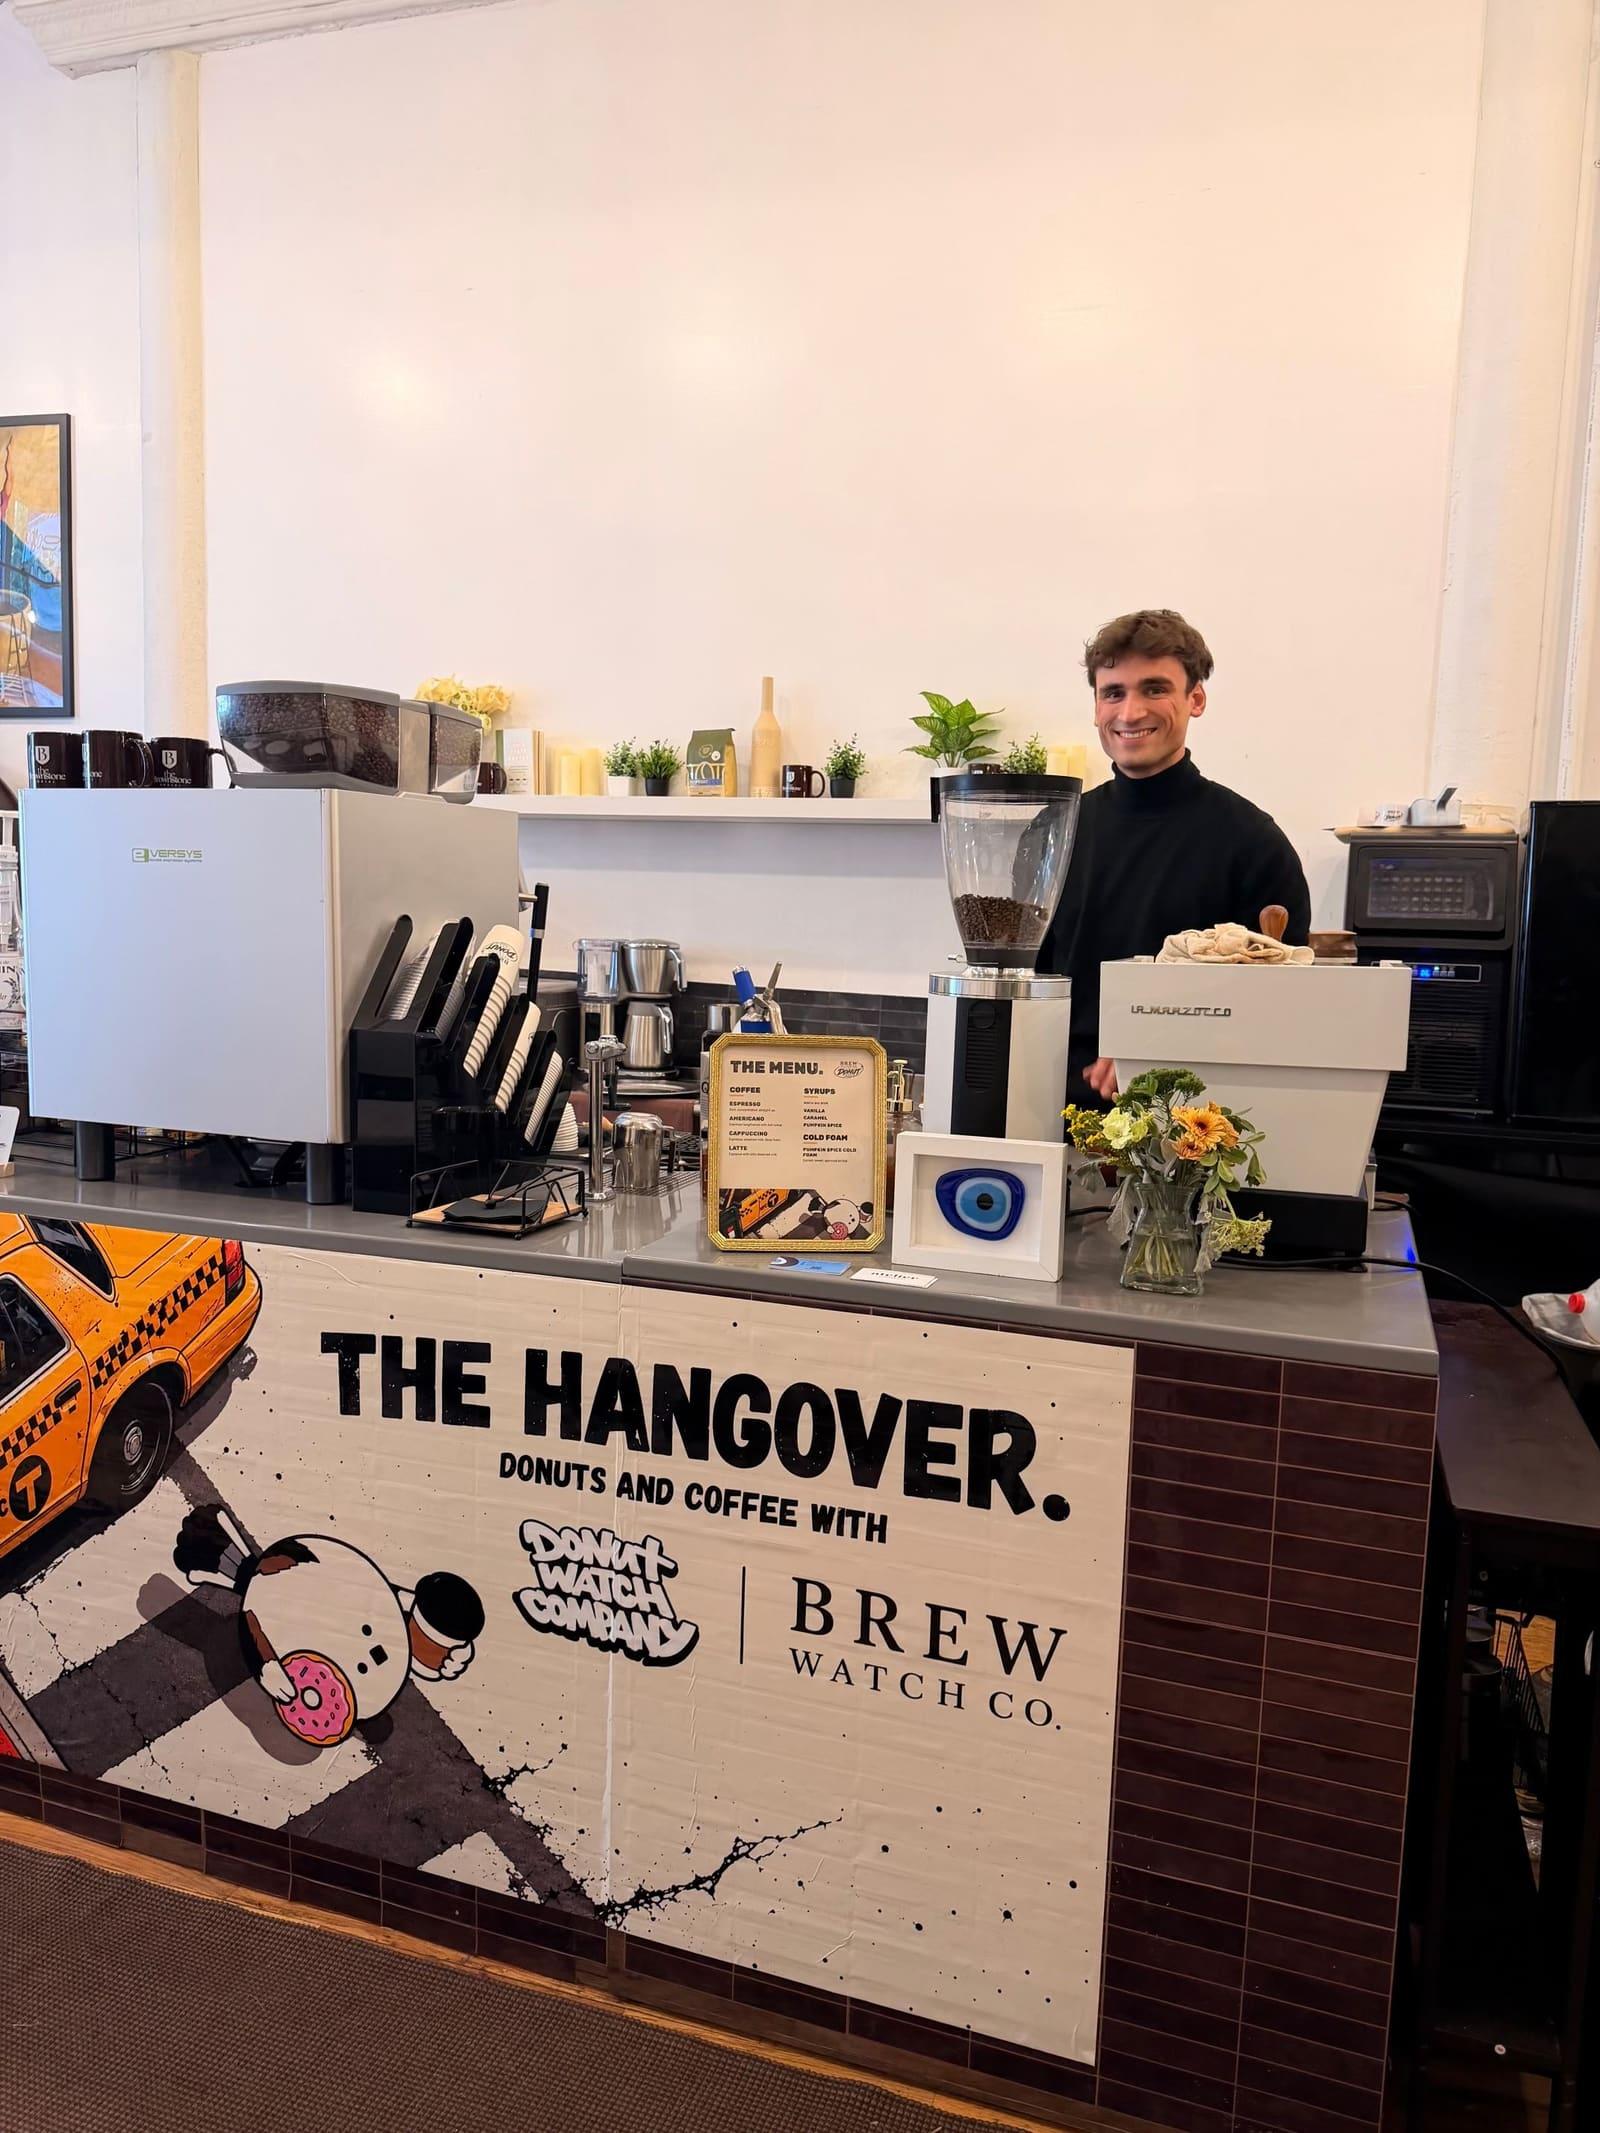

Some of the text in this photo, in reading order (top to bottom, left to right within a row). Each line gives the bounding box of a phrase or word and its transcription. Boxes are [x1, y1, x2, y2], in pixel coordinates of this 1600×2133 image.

[730, 1060, 824, 1075] THE MENU.
[730, 1086, 761, 1094] COFFEE
[320, 1331, 1071, 1522] THE HANGOVER.
[499, 1452, 888, 1544] DONUTS AND COFFEE WITH
[512, 1587, 700, 1667] COMPANY
[535, 1562, 677, 1619] WATCH
[790, 1576, 1068, 1683] BREW
[789, 1647, 1064, 1731] WATCH CO.
